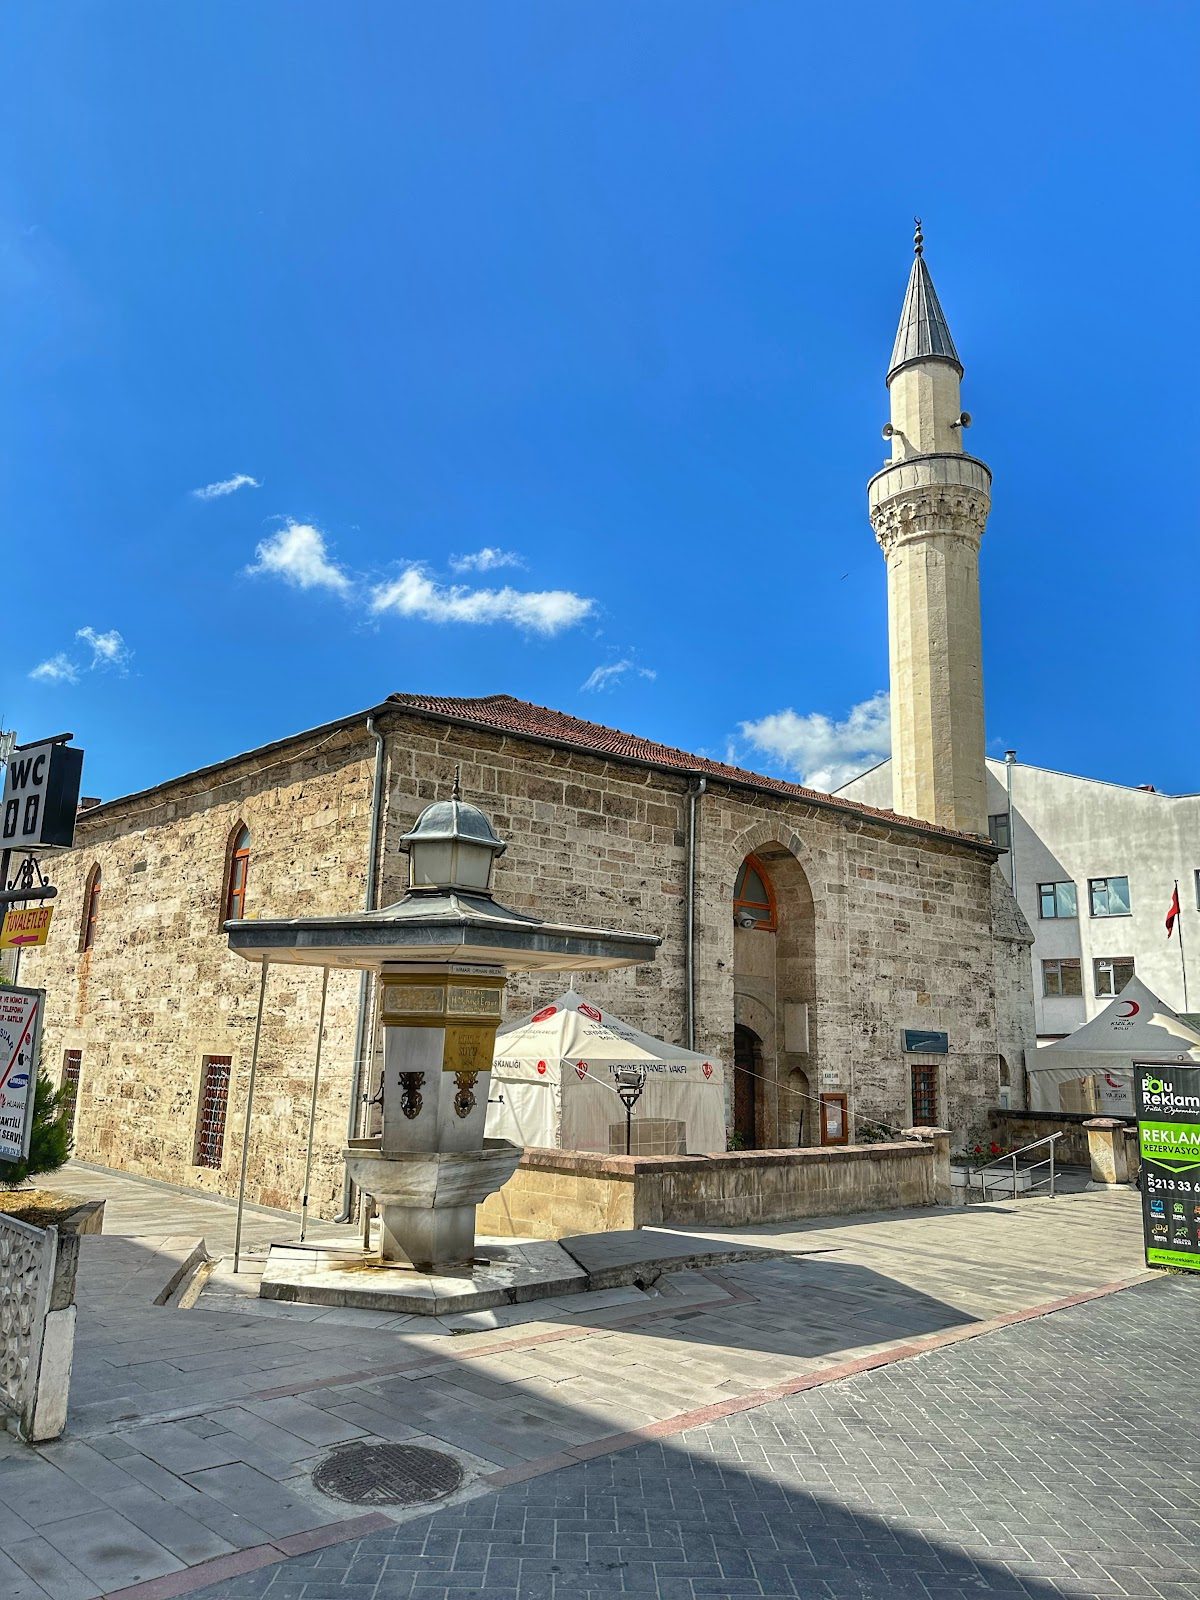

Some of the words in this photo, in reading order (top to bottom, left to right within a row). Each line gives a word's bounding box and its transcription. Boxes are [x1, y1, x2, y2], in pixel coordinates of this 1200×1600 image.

[11, 754, 45, 790] WC
[5, 909, 48, 932] TUVALETLER
[1142, 1078, 1172, 1094] Bolu
[1142, 1092, 1199, 1106] Reklam
[0, 1116, 20, 1128] ANTİLİ
[1155, 1179, 1175, 1190] 213
[1178, 1182, 1191, 1191] 33
